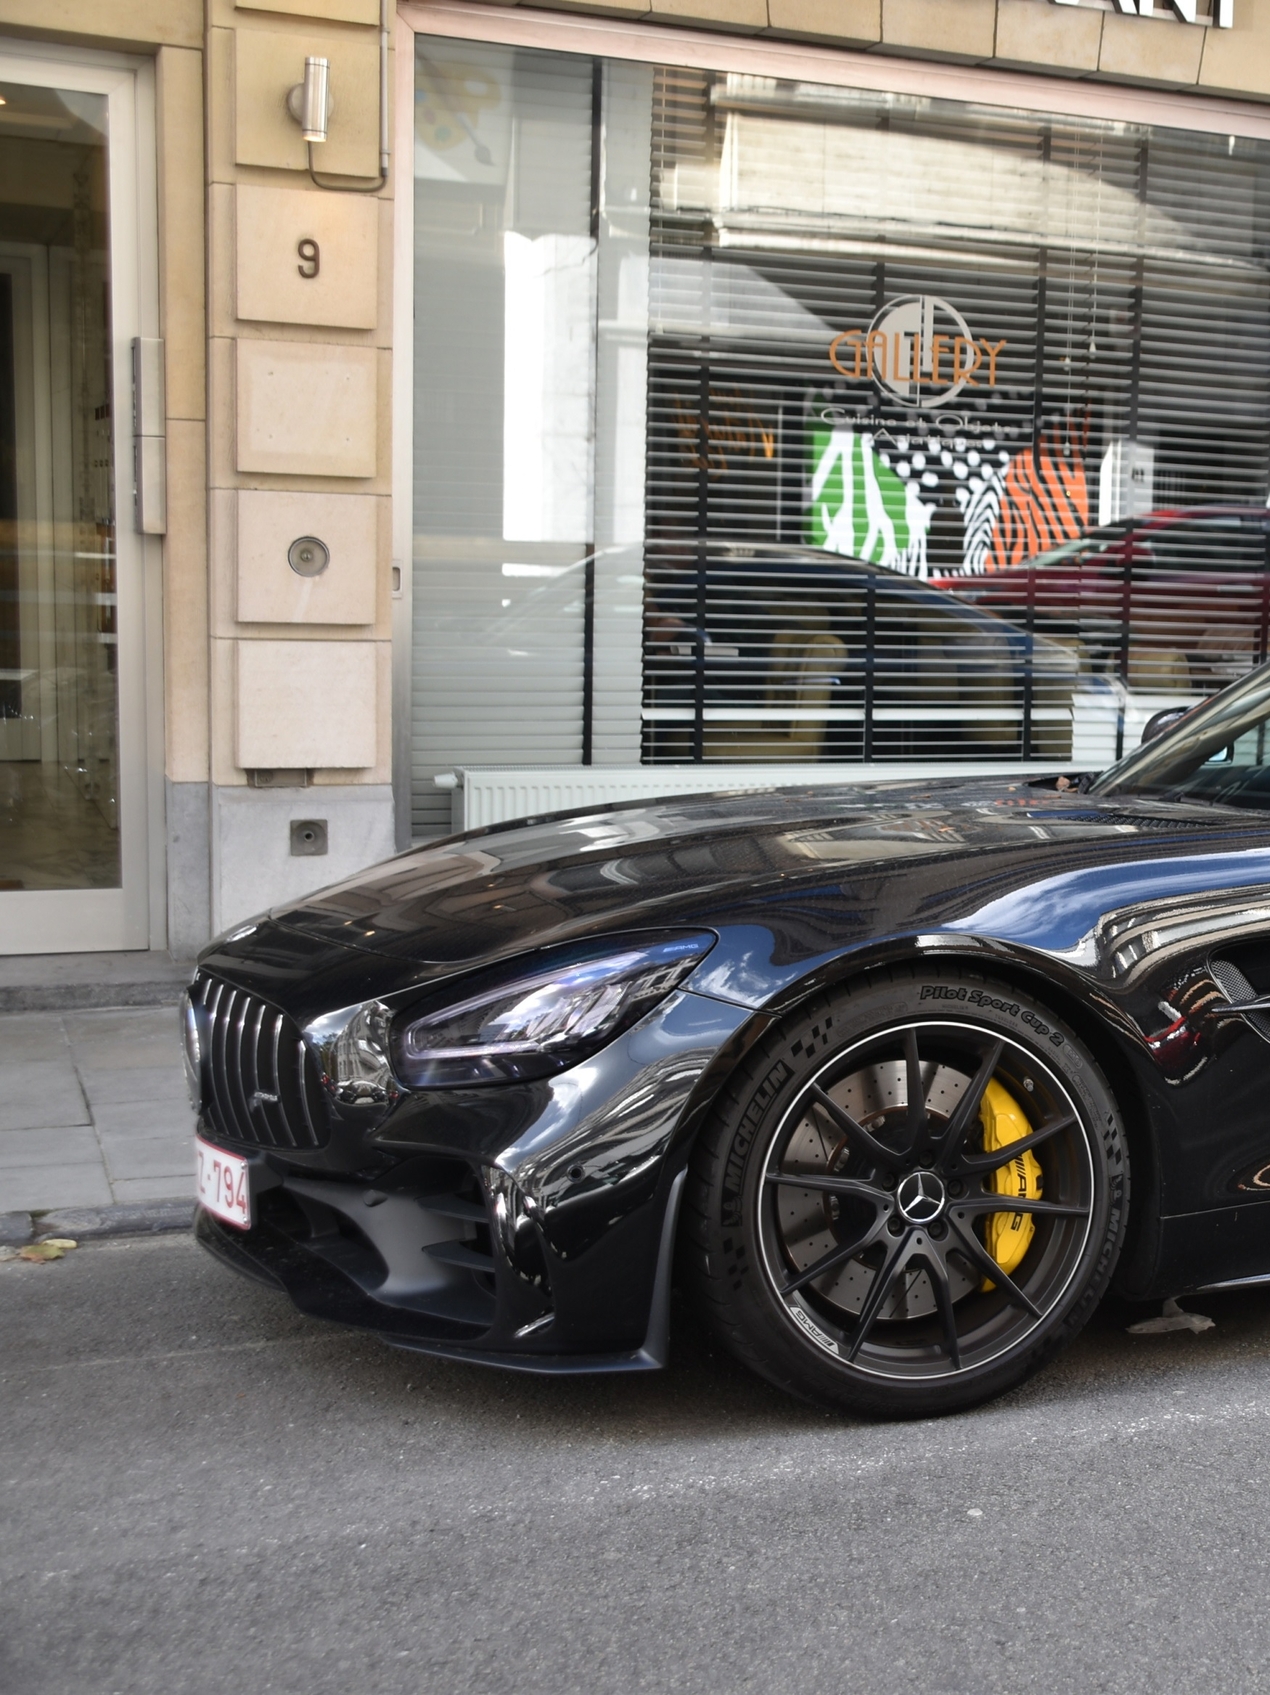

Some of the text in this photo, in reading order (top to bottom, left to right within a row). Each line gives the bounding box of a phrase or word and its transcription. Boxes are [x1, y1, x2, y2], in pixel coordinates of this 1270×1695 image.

[298, 238, 320, 279] 9
[829, 329, 1007, 388] GALLERY
[920, 985, 1065, 1047] Pilot Sport Cup 2
[724, 1061, 789, 1194] MICHELIN
